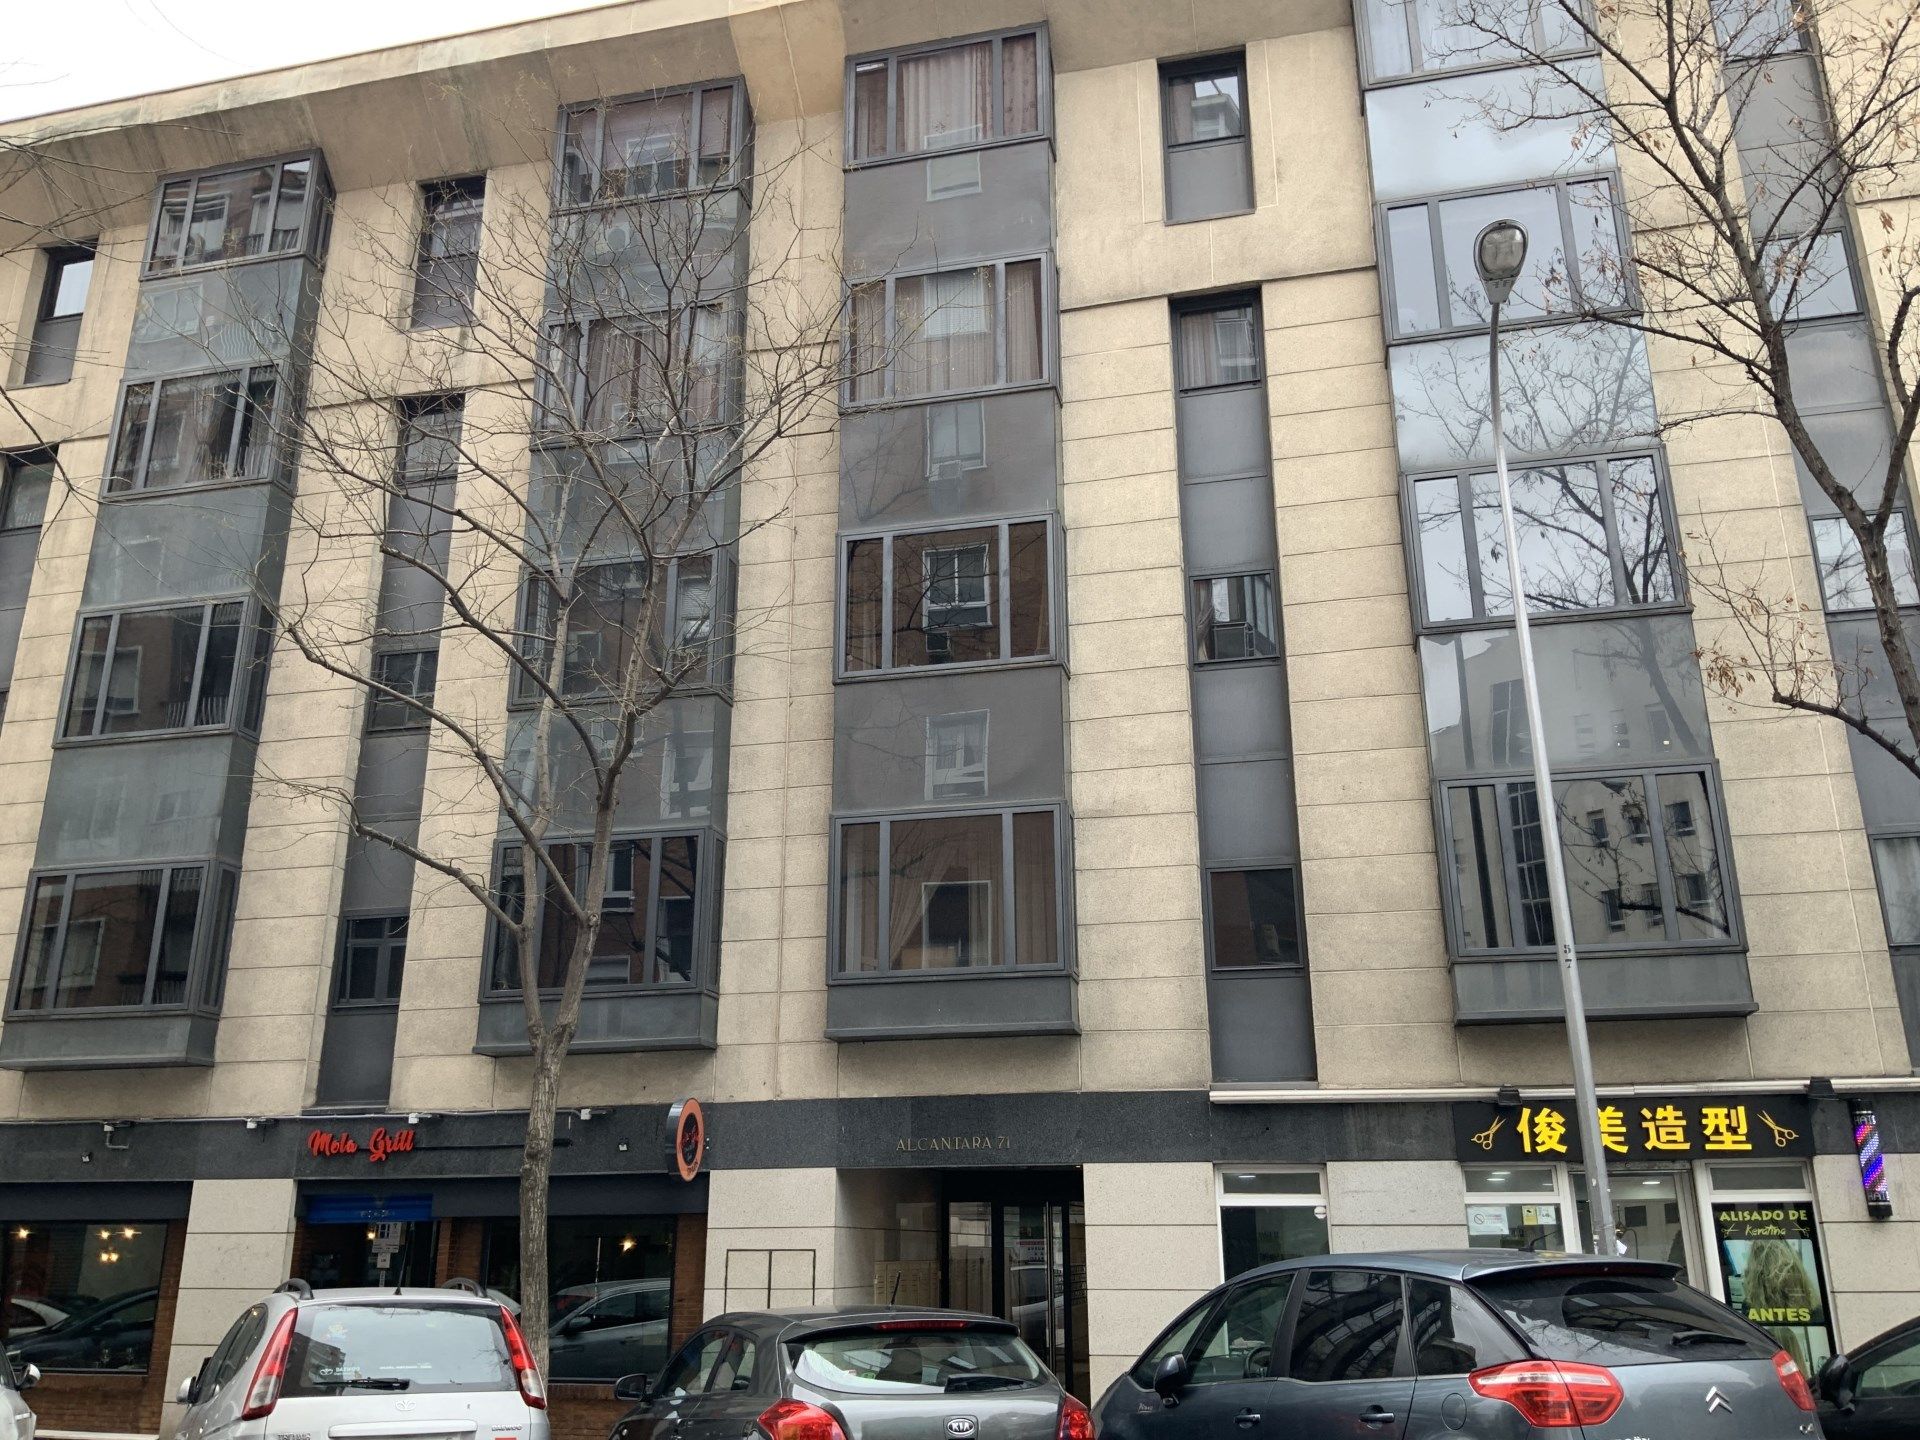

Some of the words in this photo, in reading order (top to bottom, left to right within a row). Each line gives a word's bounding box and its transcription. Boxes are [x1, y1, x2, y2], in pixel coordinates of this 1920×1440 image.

[1516, 1105, 1753, 1154] 俊美造型
[307, 1129, 358, 1156] Mola
[369, 1127, 415, 1162] Grill
[896, 1136, 992, 1151] ALCANTARA
[997, 1135, 1010, 1149] 71
[1720, 1210, 1784, 1221] ALISADO
[1789, 1210, 1808, 1220] DE
[1745, 1224, 1786, 1236] Keratina
[1748, 1308, 1811, 1322] ANTES
[952, 1422, 970, 1431] KIA
